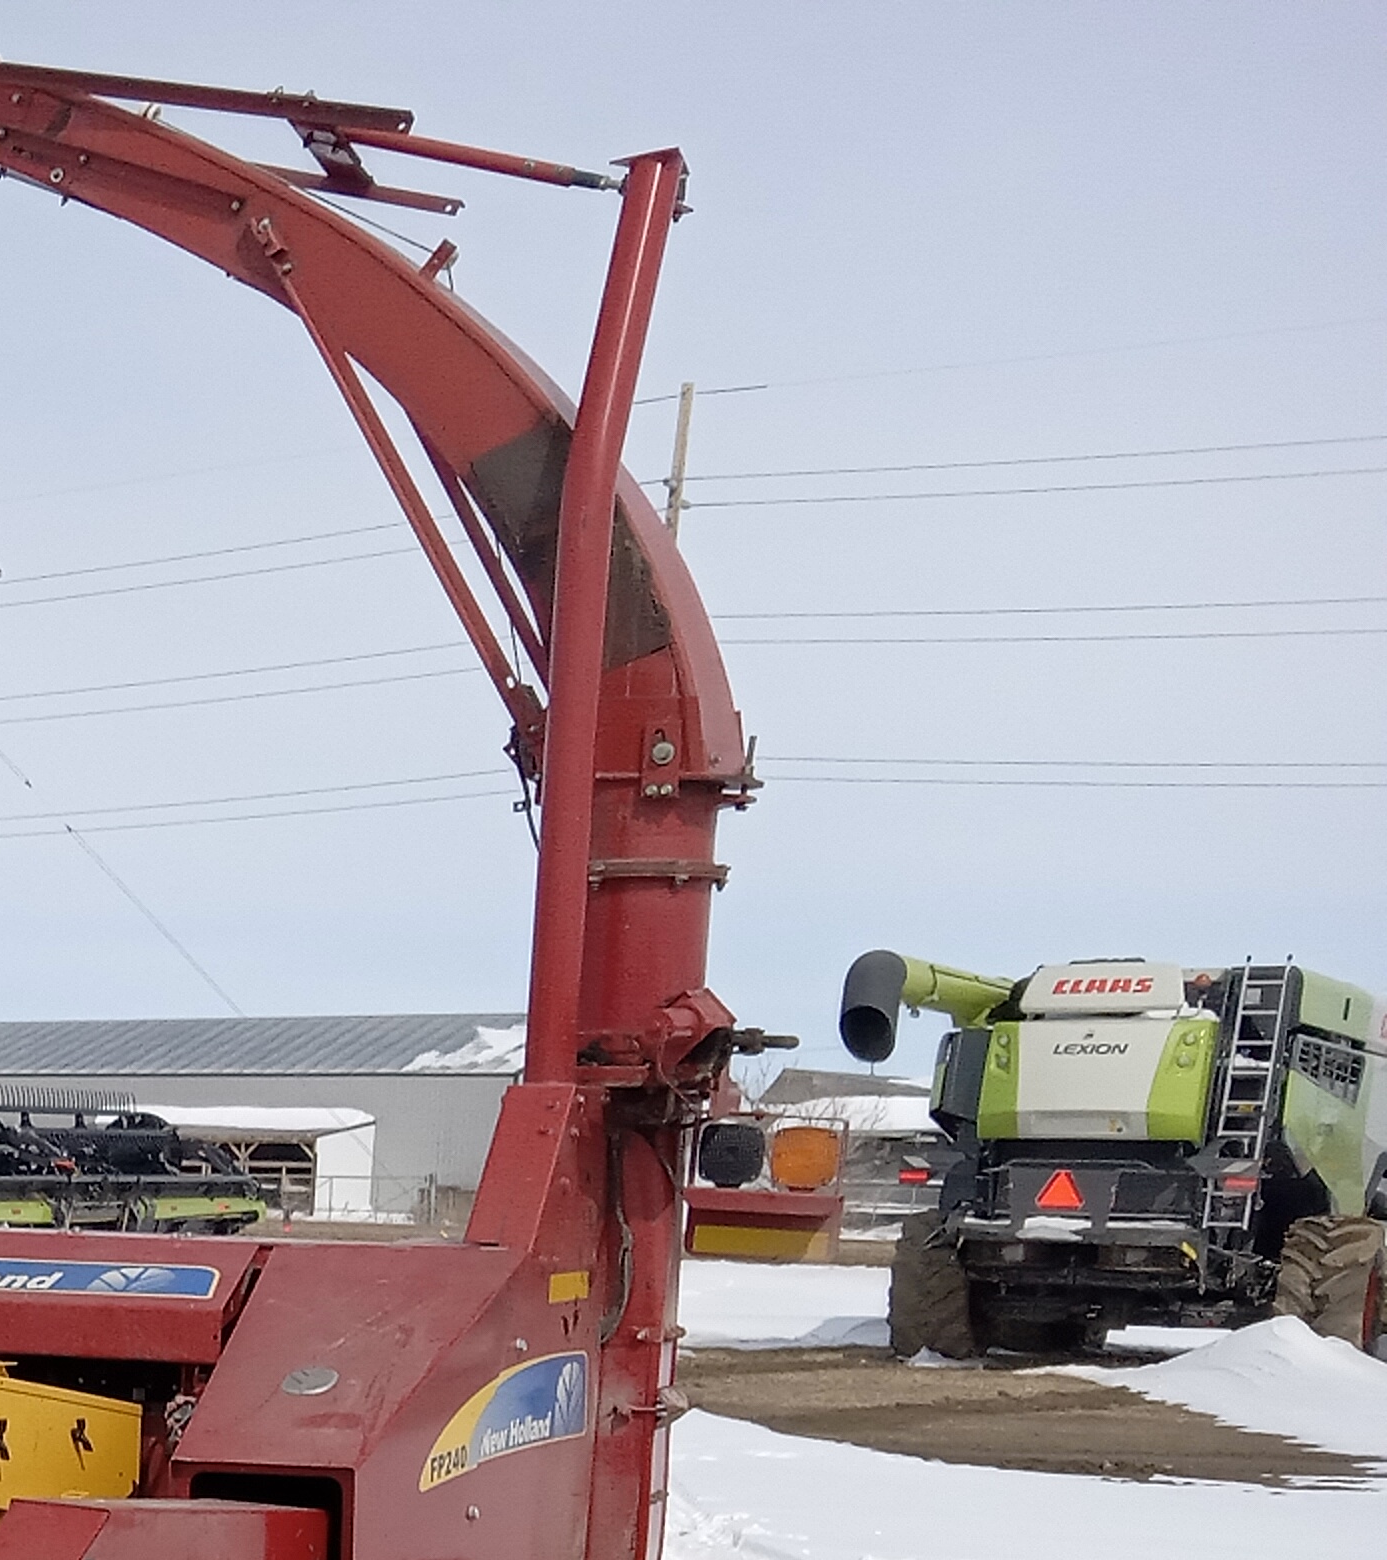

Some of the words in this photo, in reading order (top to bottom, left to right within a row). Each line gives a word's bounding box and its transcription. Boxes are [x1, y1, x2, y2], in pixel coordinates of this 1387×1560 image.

[1052, 978, 1154, 995] CLAAS
[1052, 1043, 1129, 1055] LEXION
[480, 1427, 508, 1456] New
[508, 1411, 552, 1447] Holland
[429, 1444, 469, 1482] FP240
